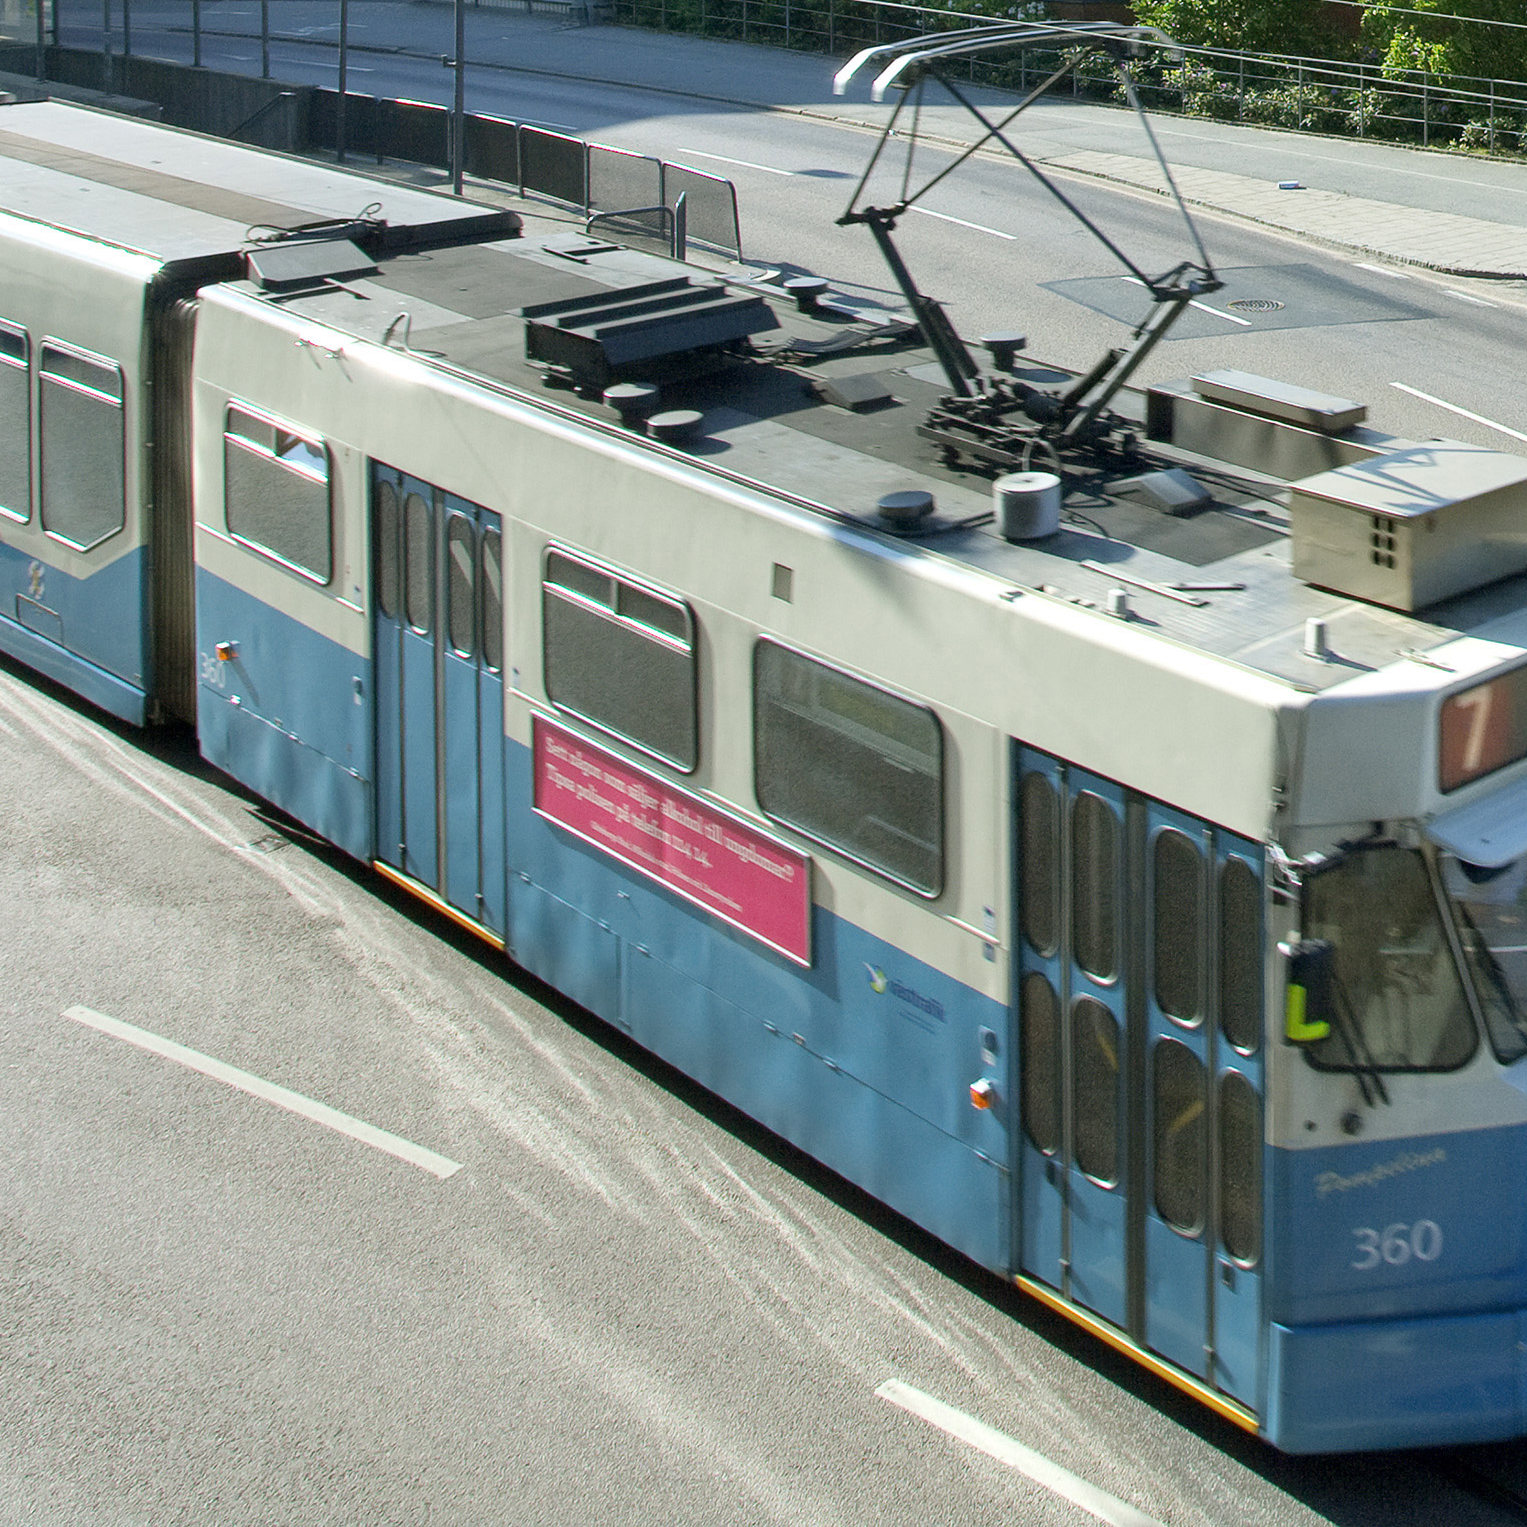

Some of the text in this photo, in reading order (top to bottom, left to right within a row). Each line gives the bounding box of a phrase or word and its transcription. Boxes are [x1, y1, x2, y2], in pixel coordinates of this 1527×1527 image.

[200, 652, 226, 689] 360
[1454, 684, 1493, 771] 7
[1351, 1219, 1443, 1270] 360
